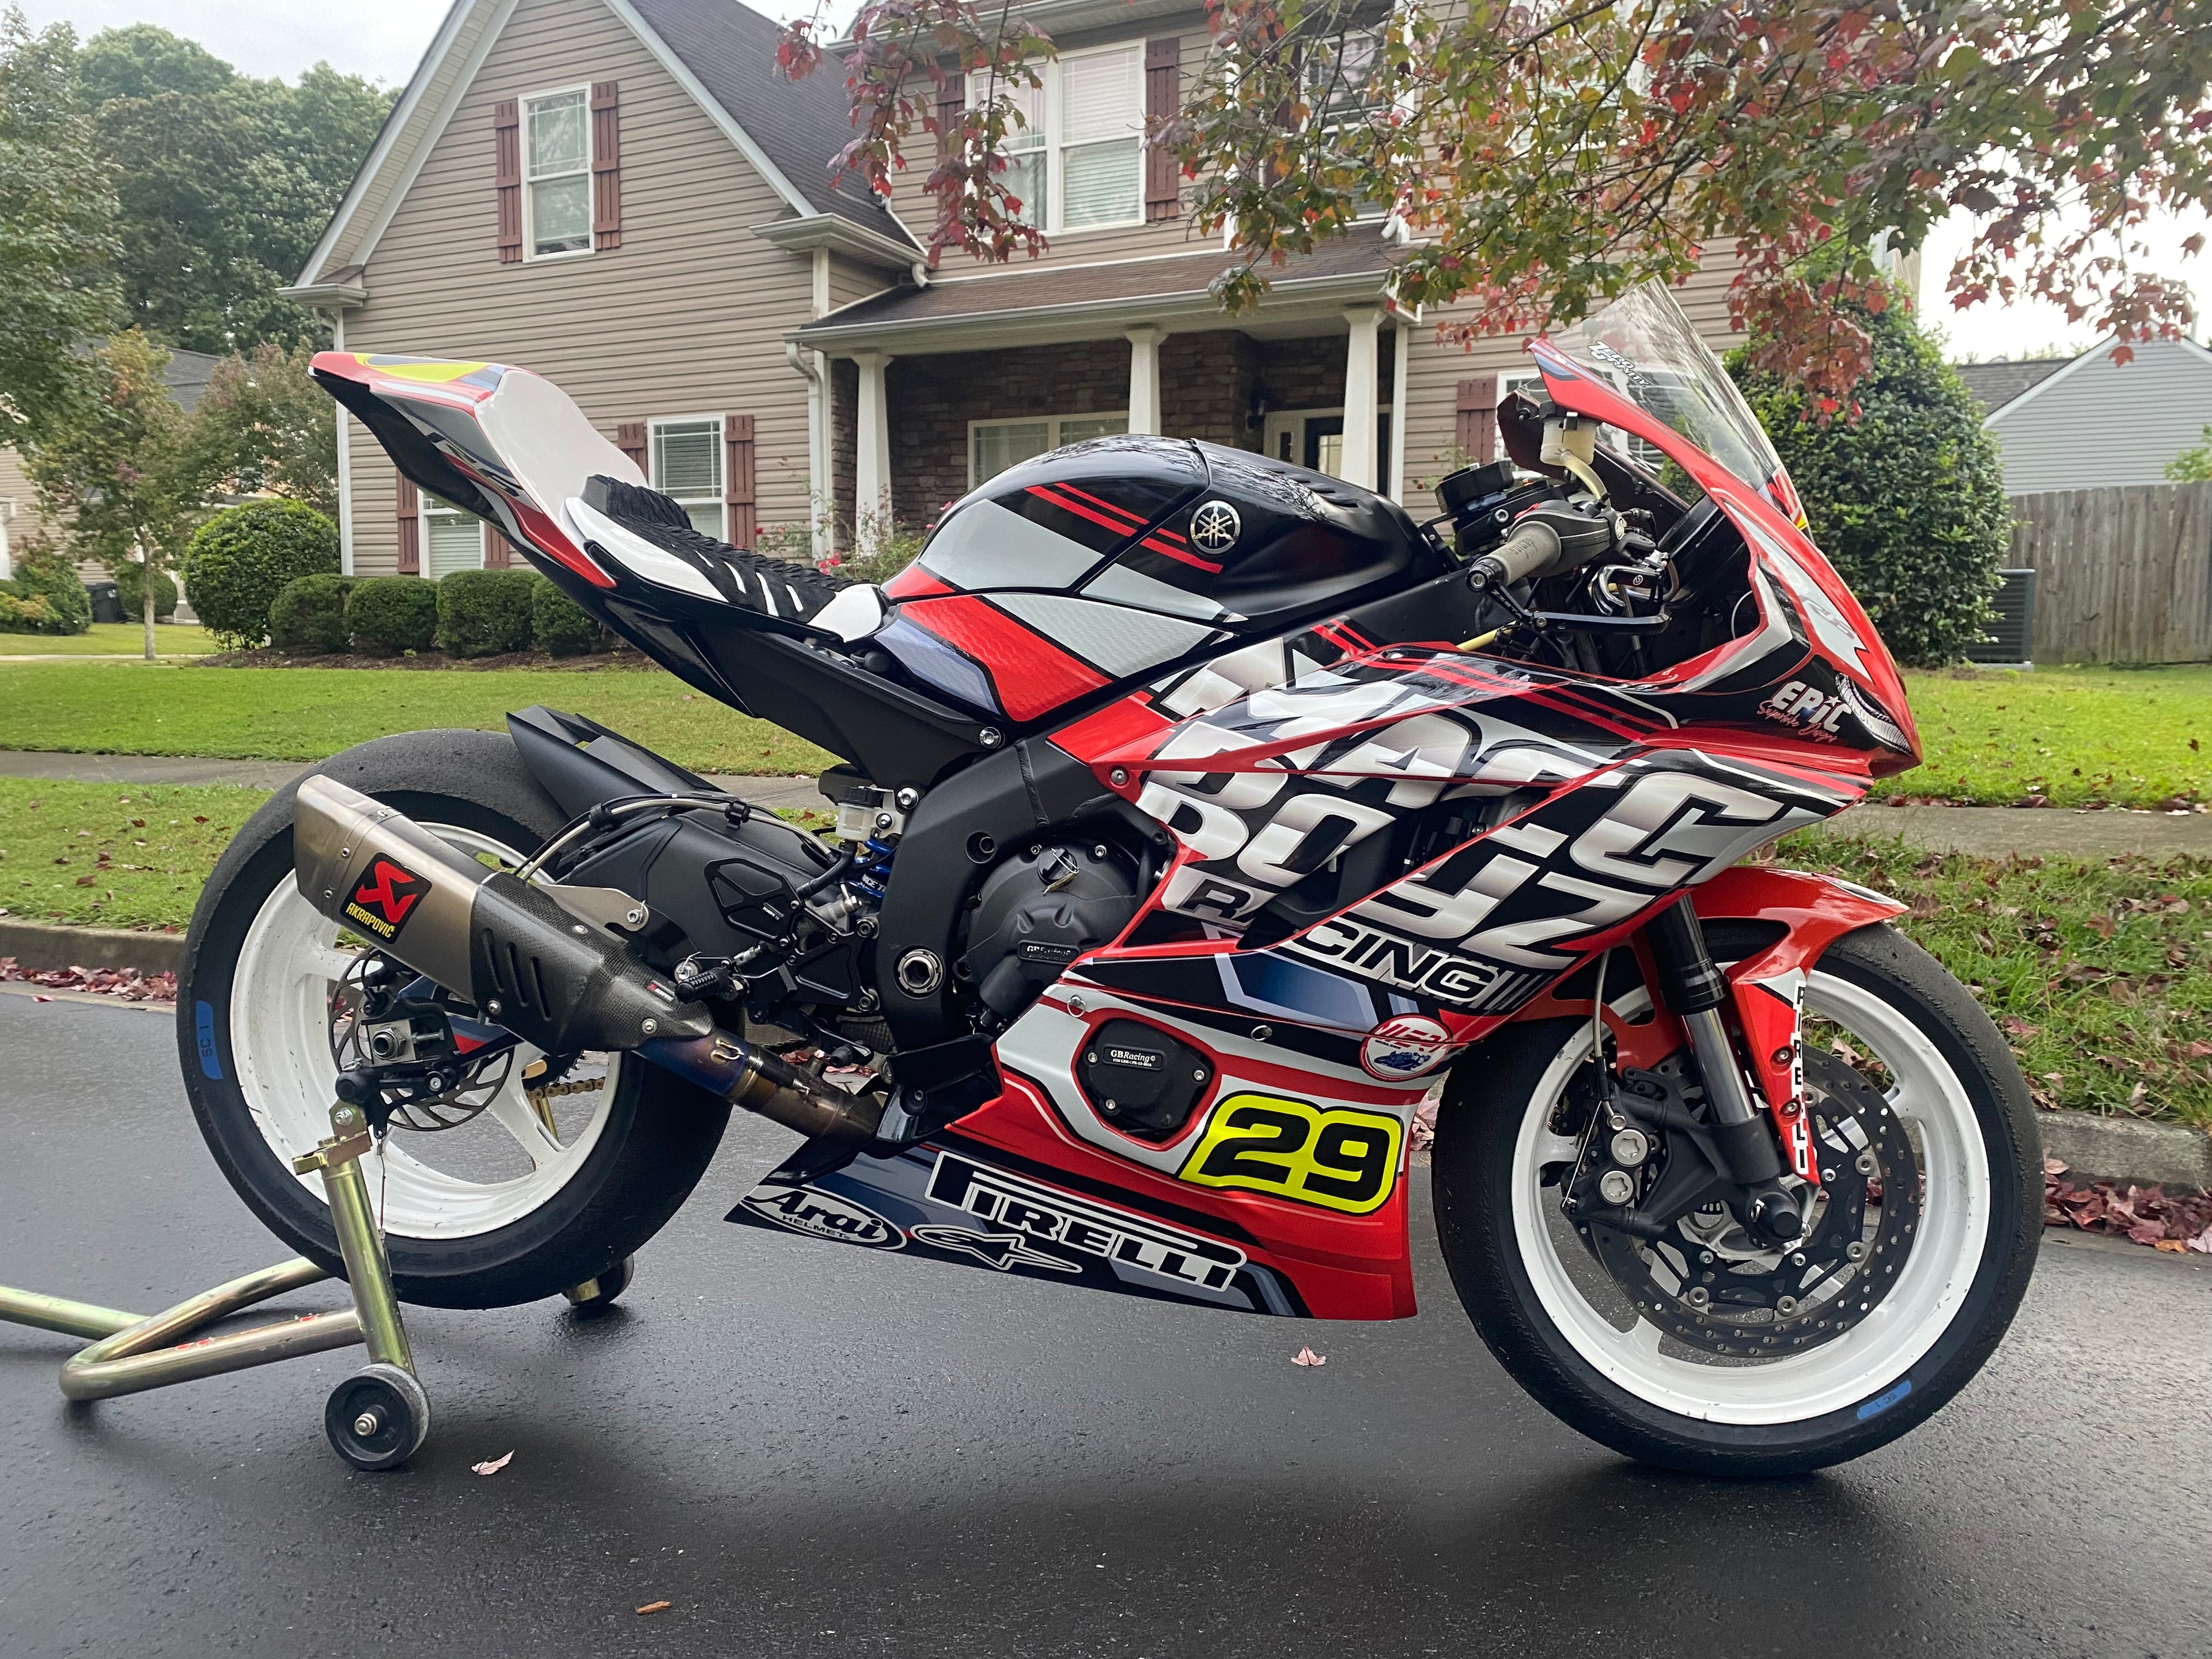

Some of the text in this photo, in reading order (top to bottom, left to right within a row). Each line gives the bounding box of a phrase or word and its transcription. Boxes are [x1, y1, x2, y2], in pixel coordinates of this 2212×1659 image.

[1588, 341, 1634, 369] ZERO
[1590, 350, 1650, 385] GRAVITY
[200, 1039, 213, 1057] SC
[1198, 1107, 1391, 1202] 29
[743, 1190, 883, 1240] Arai
[782, 1214, 844, 1239] HELMET
[927, 1153, 1244, 1290] PIRELLI
